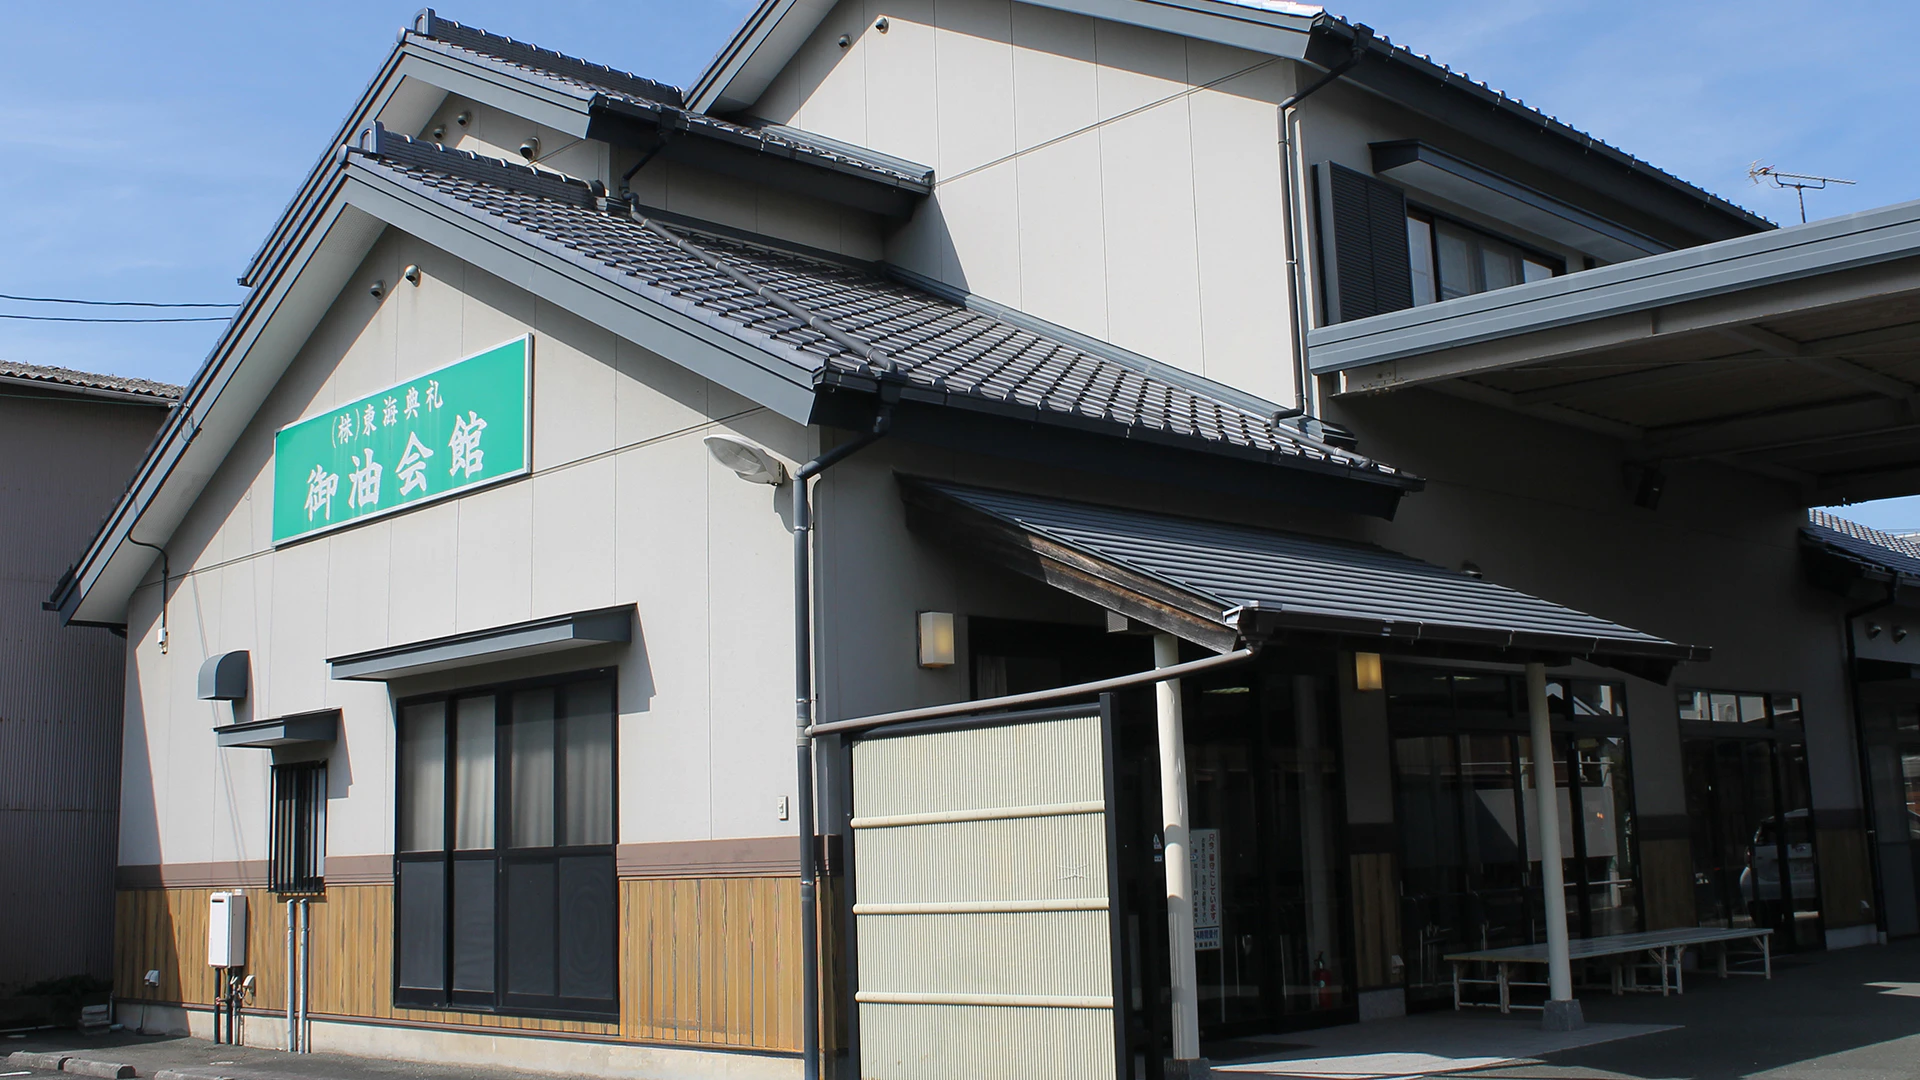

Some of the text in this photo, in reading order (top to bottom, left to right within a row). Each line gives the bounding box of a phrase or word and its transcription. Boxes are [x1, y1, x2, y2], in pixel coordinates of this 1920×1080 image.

[332, 380, 443, 448] (株)東海典礼
[304, 411, 487, 521] 御油会館
